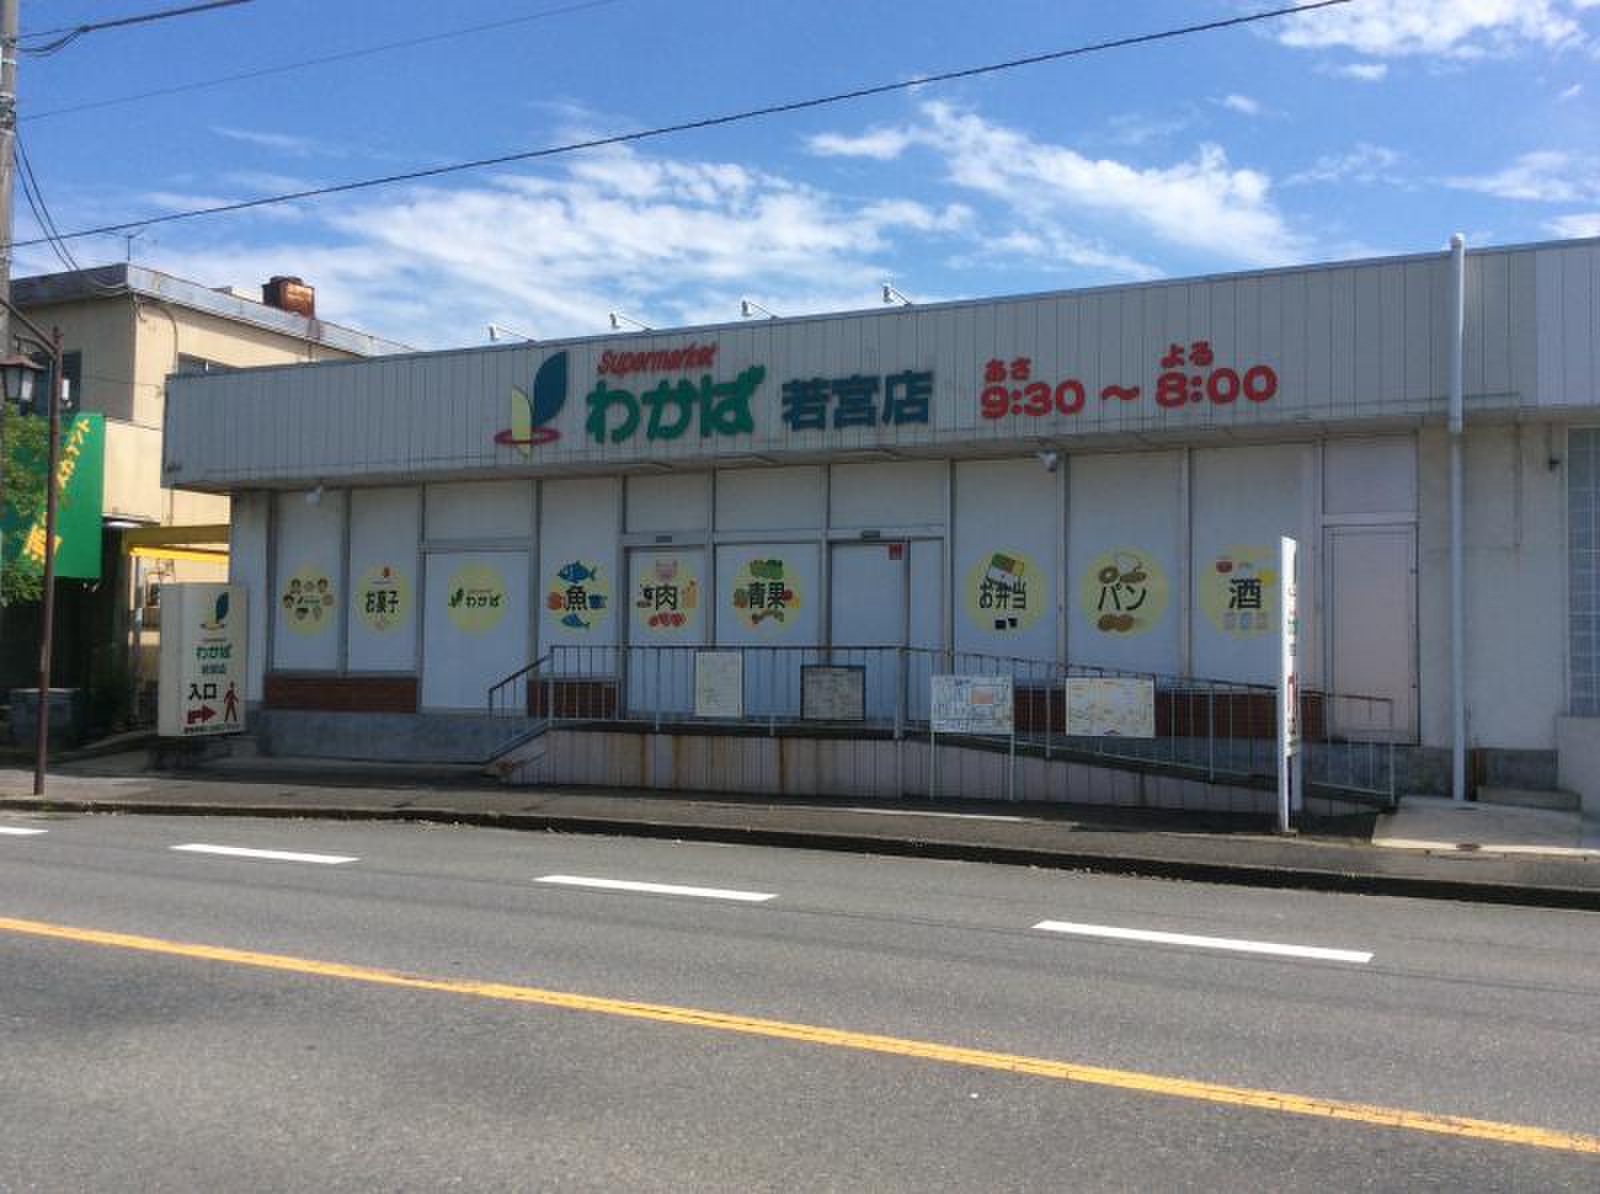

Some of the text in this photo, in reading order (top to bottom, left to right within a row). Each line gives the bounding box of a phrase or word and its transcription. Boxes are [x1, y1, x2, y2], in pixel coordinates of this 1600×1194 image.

[597, 343, 718, 375] Supermarket
[1161, 341, 1213, 368] よる
[984, 358, 1031, 383] あさ
[585, 365, 765, 443] わかば
[781, 370, 933, 430] 若宮店
[981, 379, 1085, 419] 9:30
[1156, 365, 1277, 408] 8:00
[365, 590, 400, 614] お菓子
[466, 594, 502, 608] わかば
[565, 585, 588, 611] 魚
[655, 584, 678, 611] 肉
[749, 582, 786, 609] 青果
[979, 575, 1026, 609] お弁当
[1098, 583, 1147, 612] パン
[1229, 577, 1262, 609] 酒
[196, 643, 232, 660] わかば
[188, 683, 217, 700] 入口
